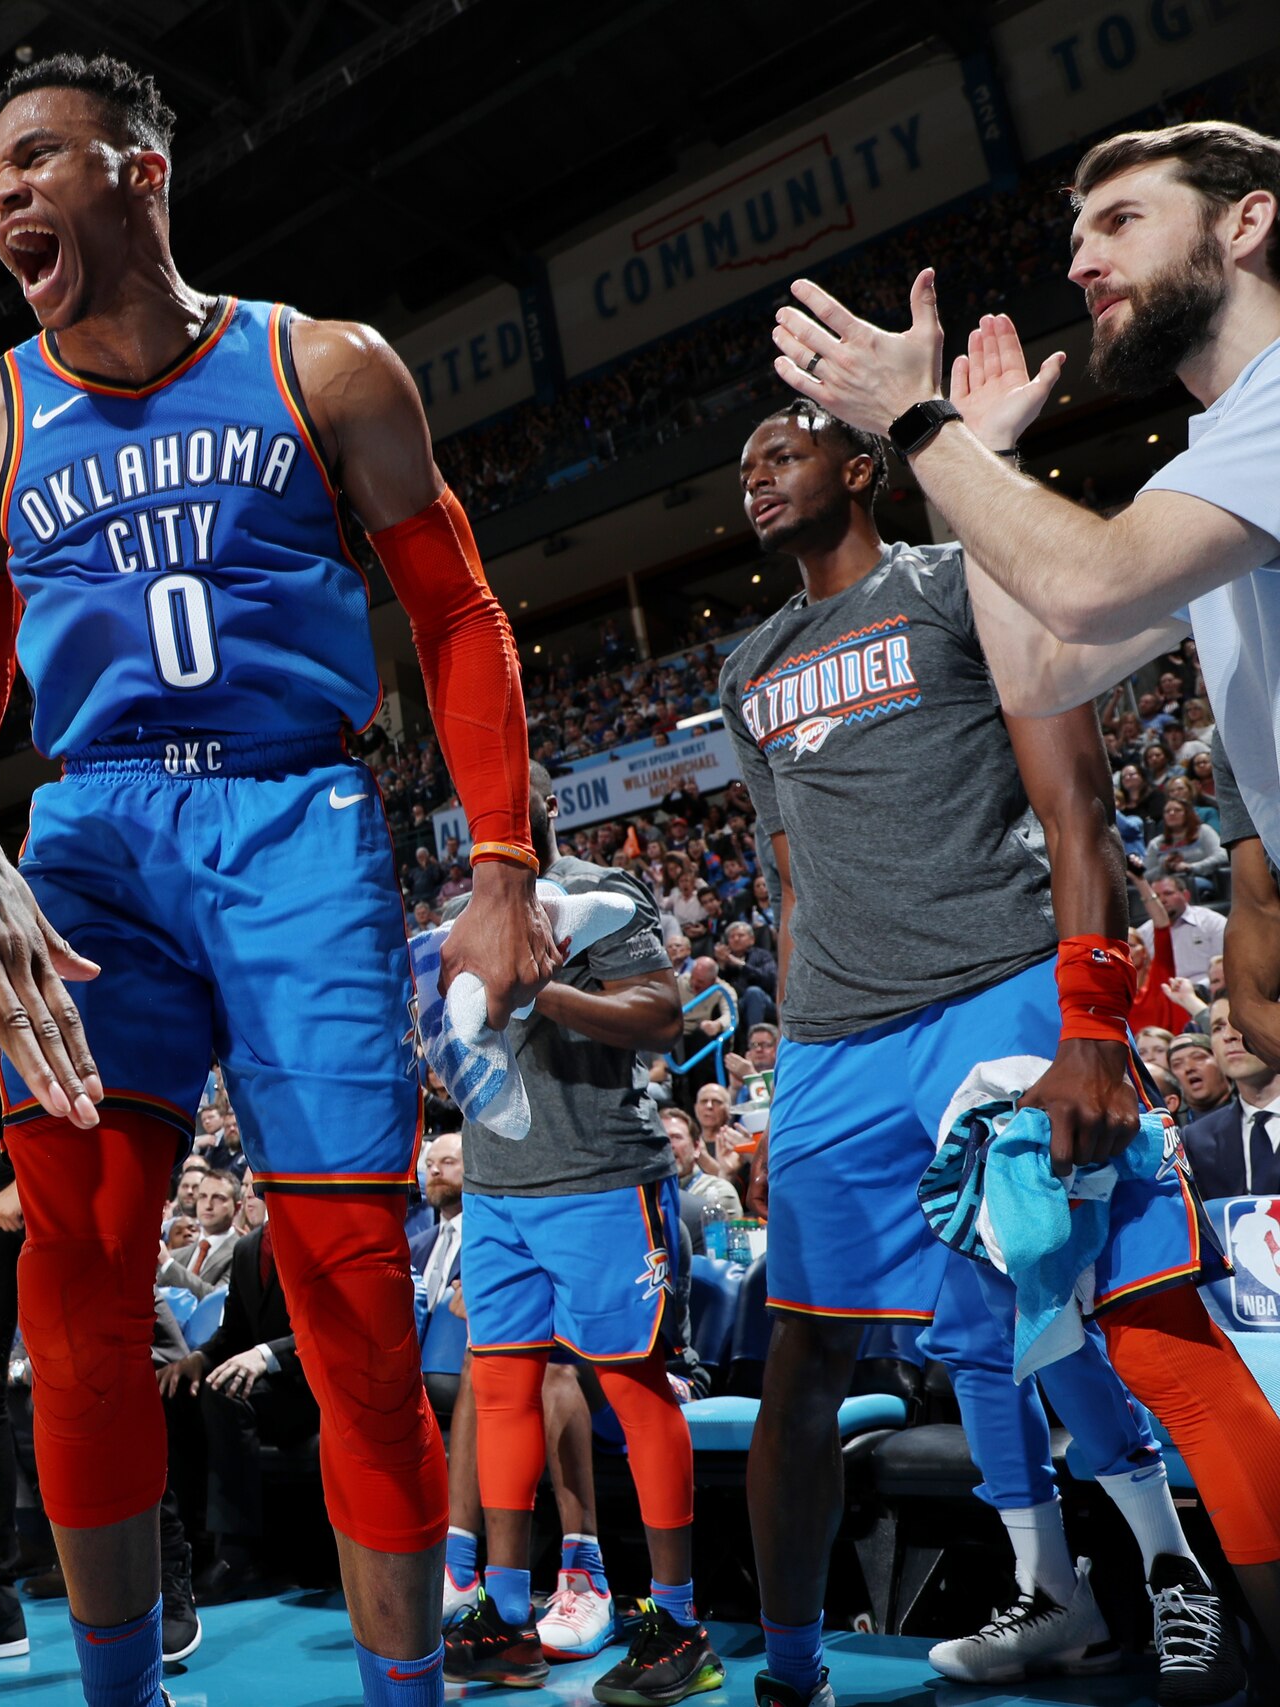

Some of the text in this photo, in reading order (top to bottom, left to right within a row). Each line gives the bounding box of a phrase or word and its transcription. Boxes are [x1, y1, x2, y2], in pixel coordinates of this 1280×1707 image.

[973, 84, 1000, 140] 324
[593, 113, 920, 318] COMMUNITY
[19, 424, 299, 545] OKLAHOMA
[103, 499, 222, 574] CITY
[144, 571, 220, 692] 0
[766, 635, 916, 732] THUNDER
[164, 740, 223, 777] OKC
[623, 753, 719, 793] WILLIAM MICHAEL
[554, 776, 609, 818] SON
[1243, 1294, 1279, 1317] NBA
